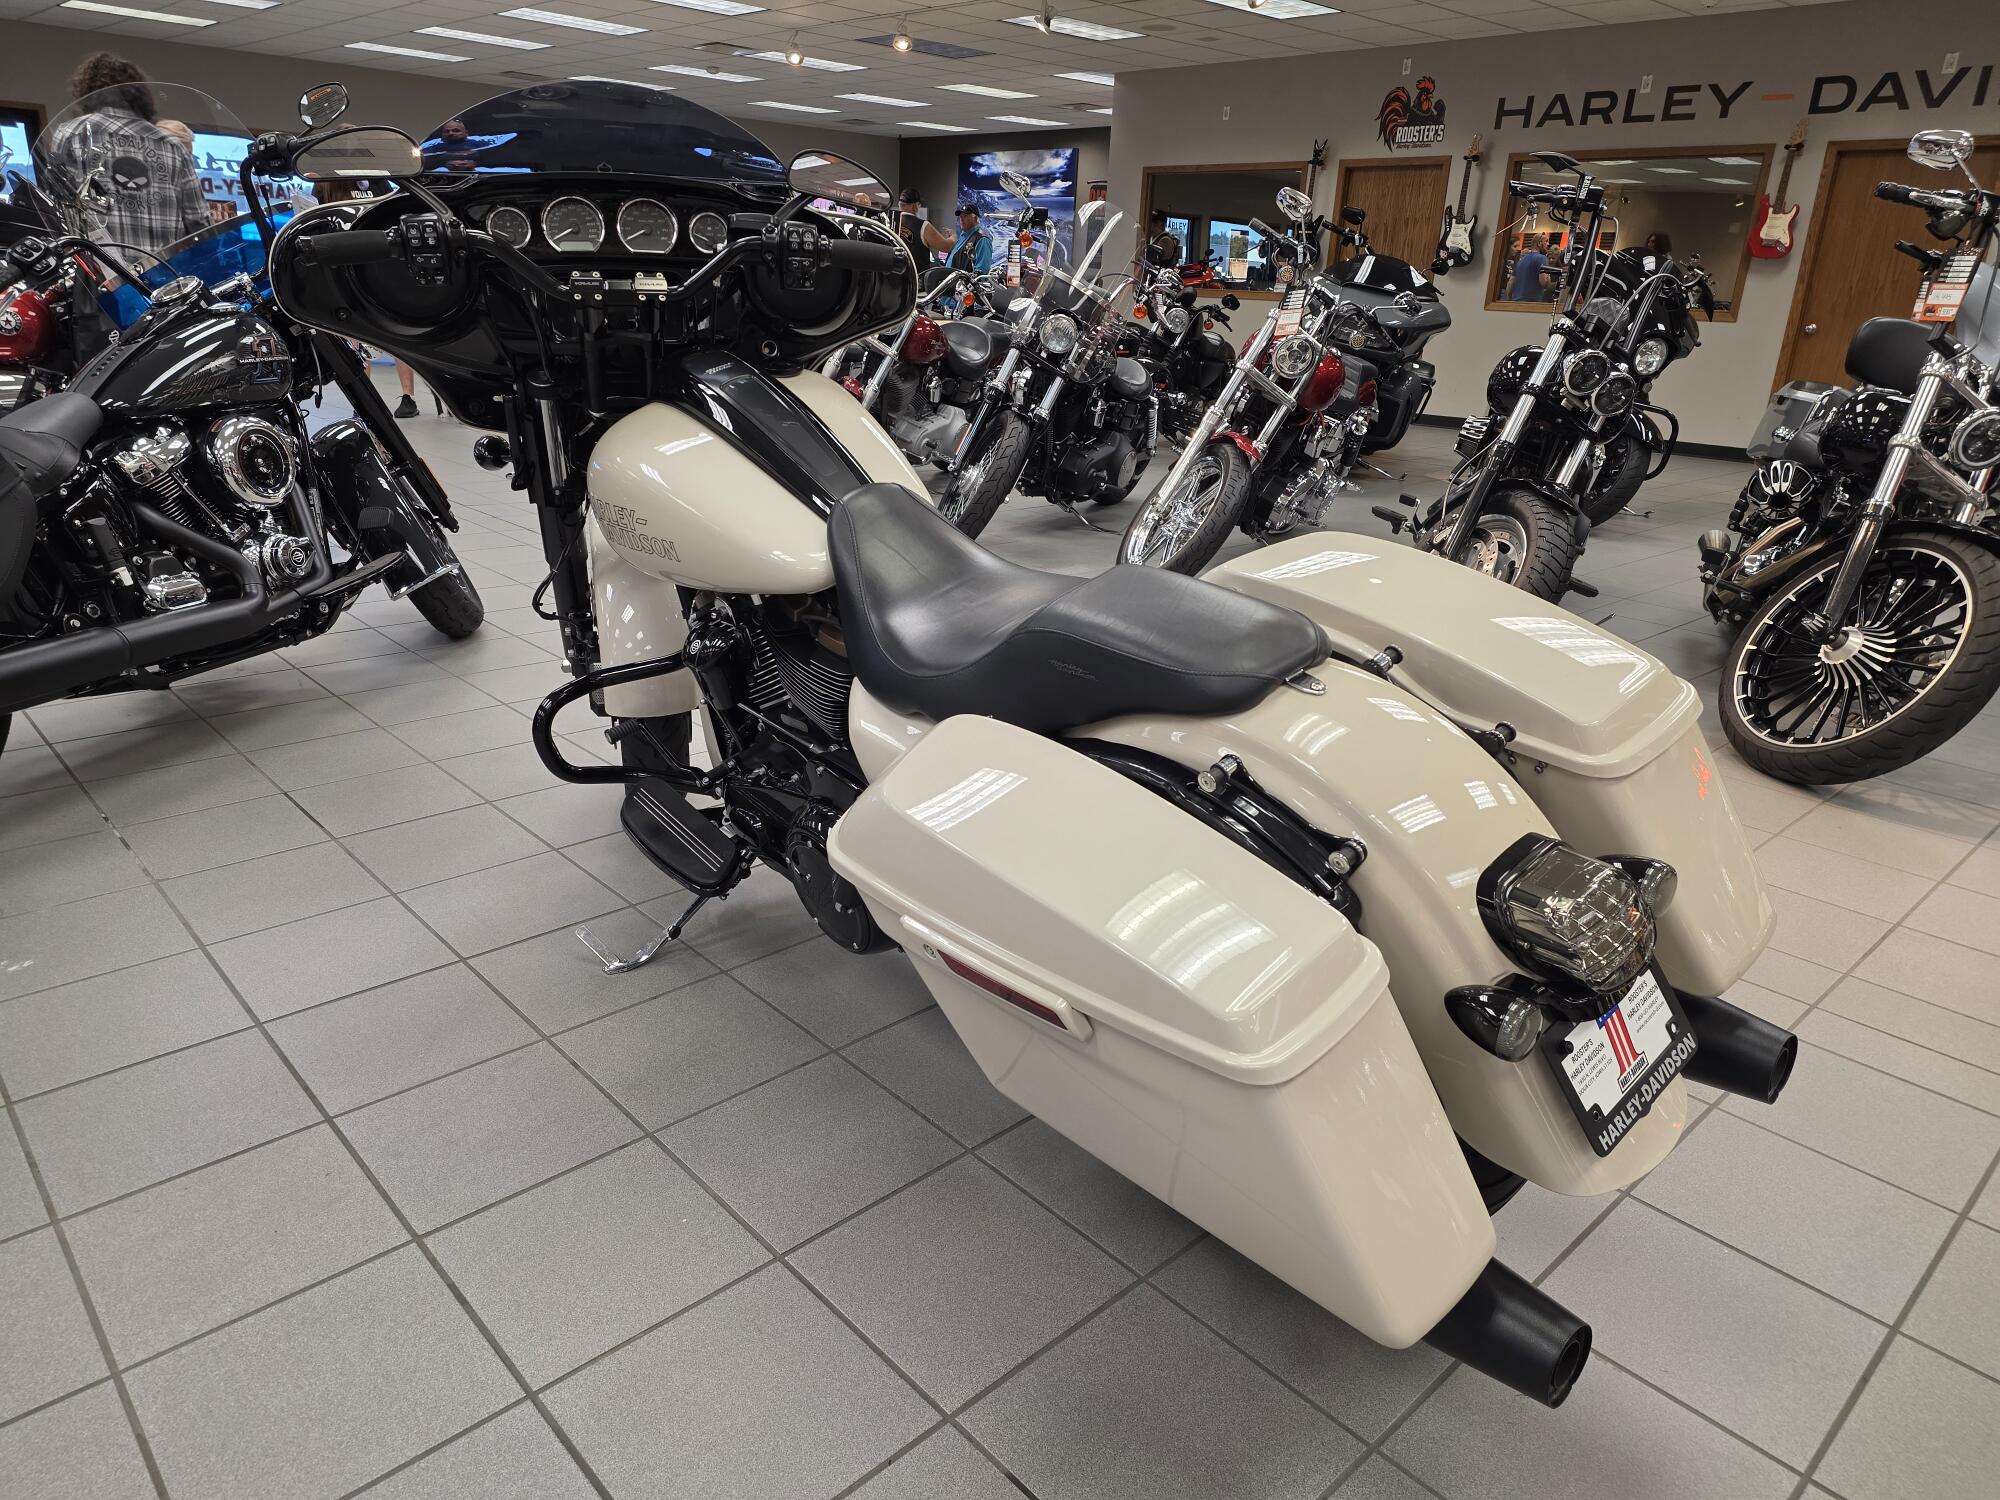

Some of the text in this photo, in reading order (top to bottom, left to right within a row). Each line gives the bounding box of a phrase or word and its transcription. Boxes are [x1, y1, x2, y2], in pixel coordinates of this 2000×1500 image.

[1395, 124, 1445, 143] ROOSTER'S
[591, 497, 647, 531] RLEY-
[1626, 983, 1659, 1020] HARLEY DAVIDSON
[1627, 979, 1648, 1004] ROOSTER'S
[1570, 1041, 1605, 1081] HARLEY DAVIDSON
[1571, 1038, 1594, 1064] ROOSTER'S
[1598, 1033, 1697, 1151] HARLEY-DAVIDSON
